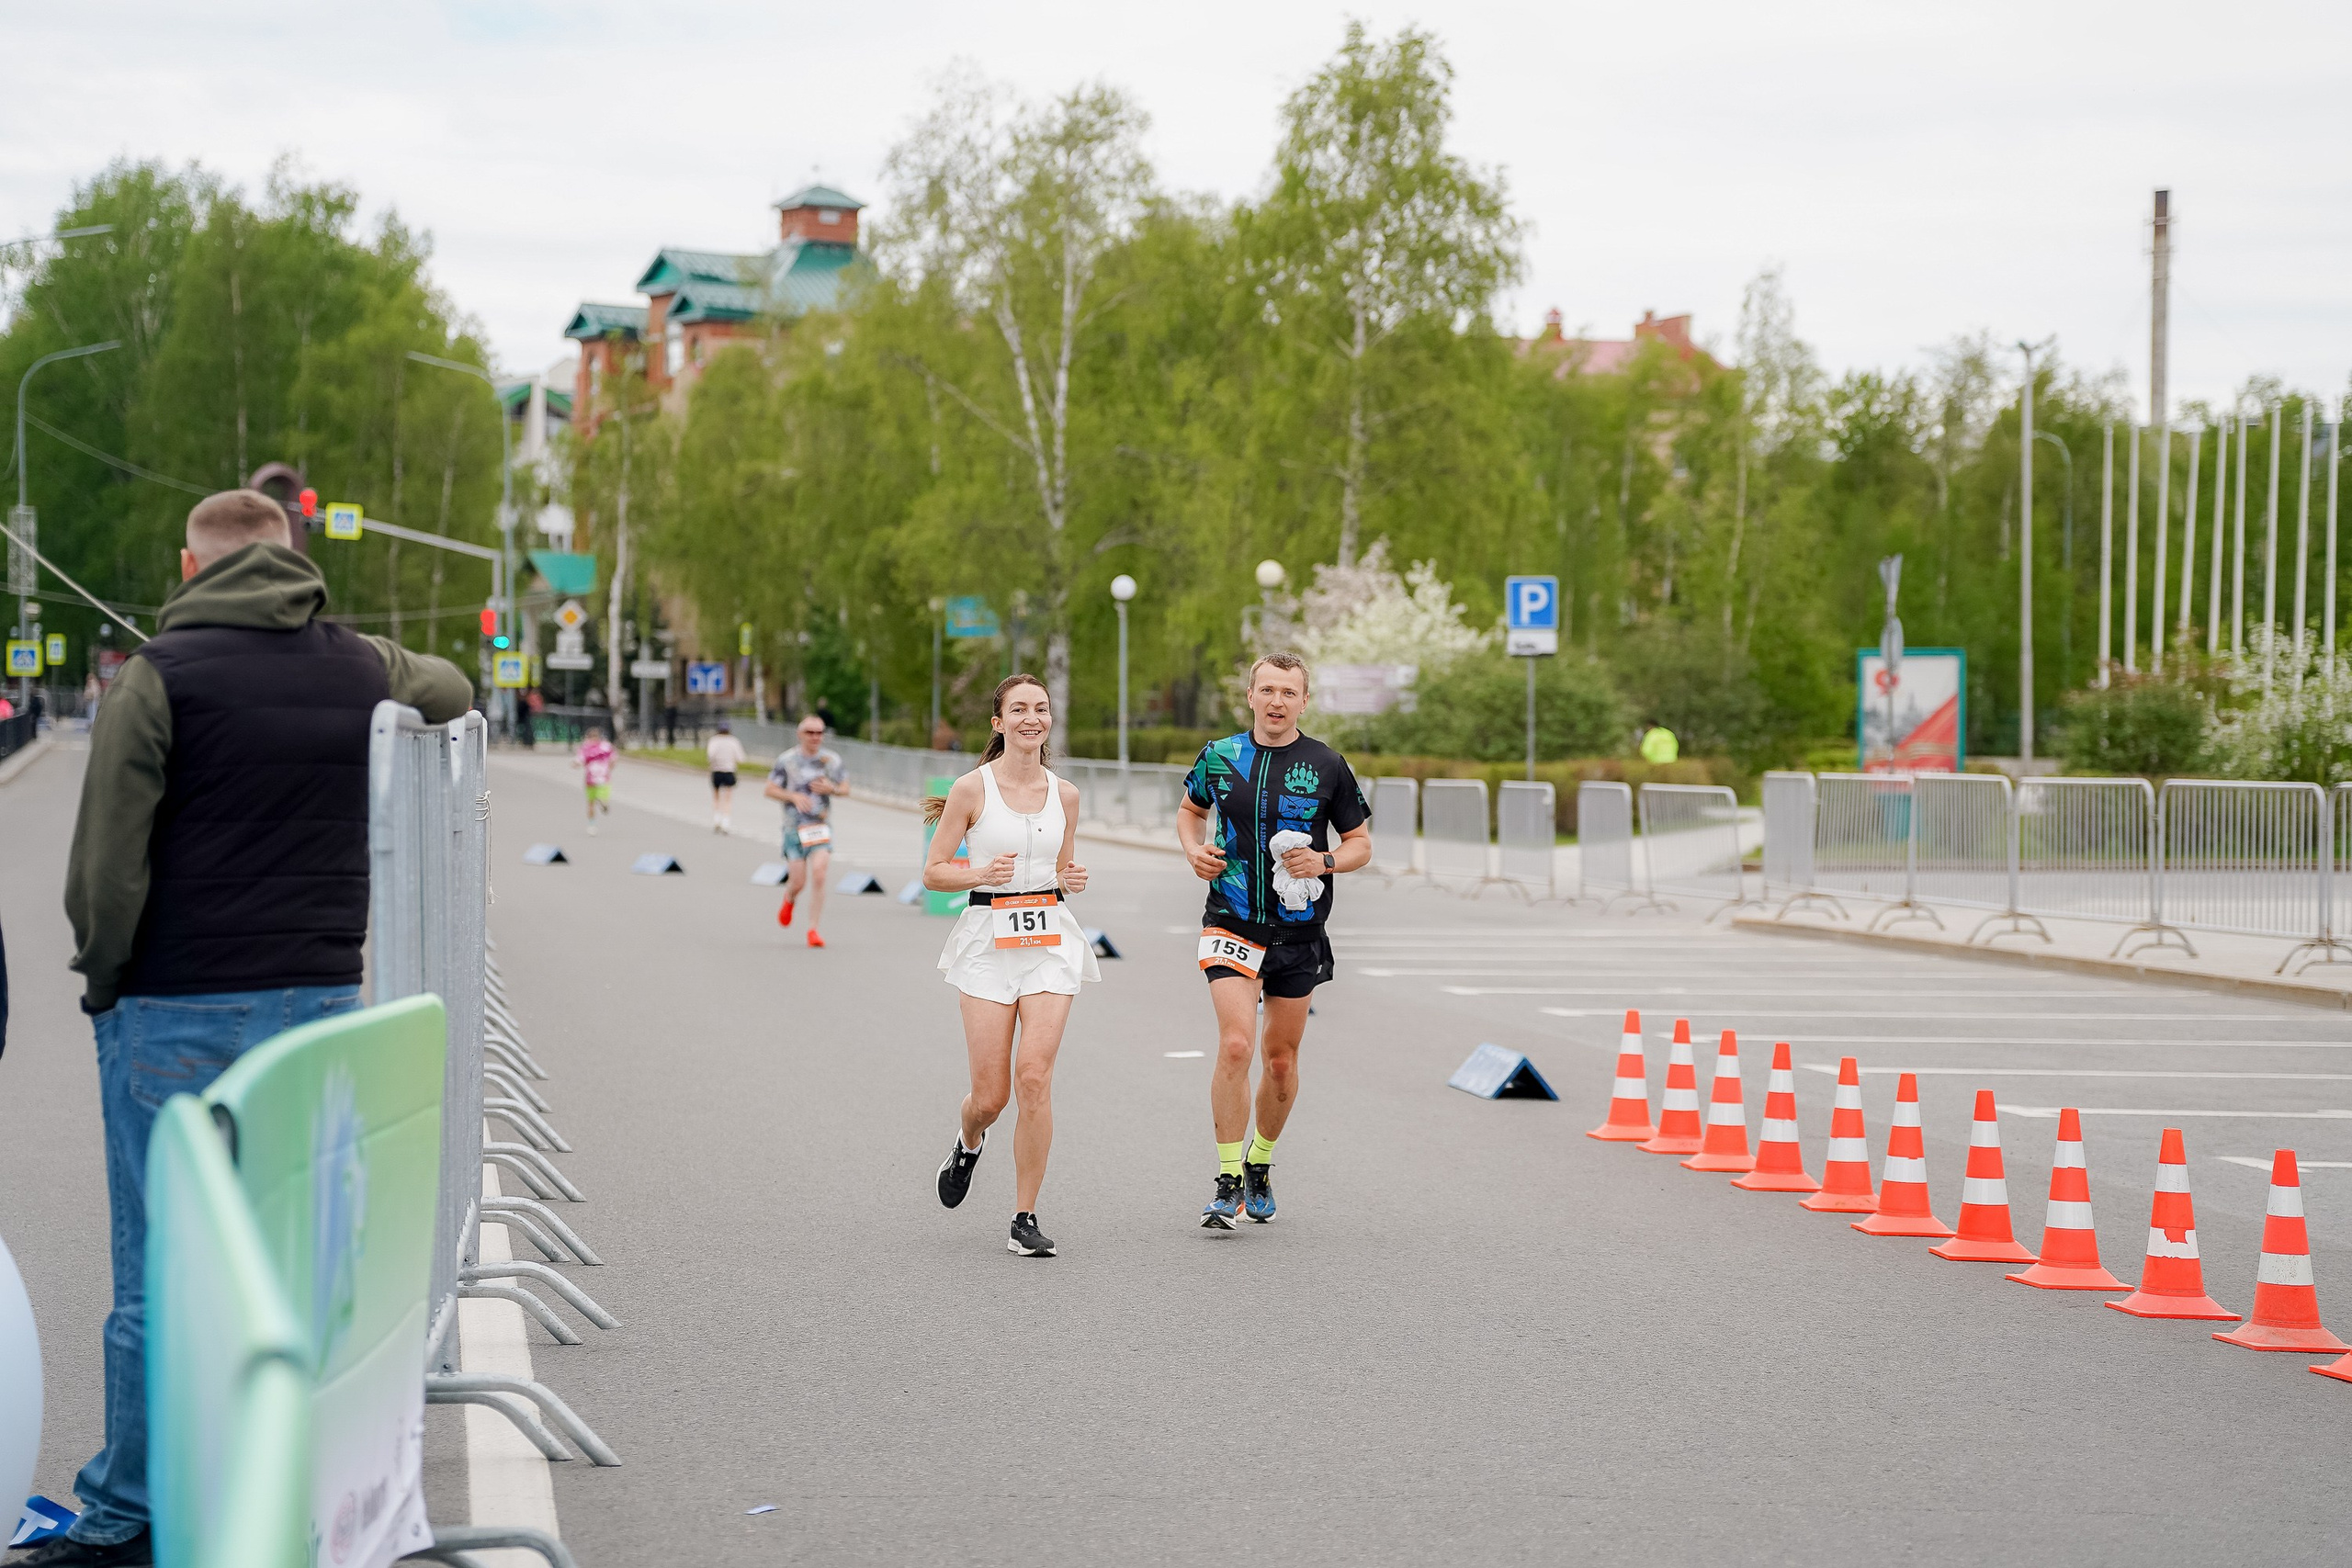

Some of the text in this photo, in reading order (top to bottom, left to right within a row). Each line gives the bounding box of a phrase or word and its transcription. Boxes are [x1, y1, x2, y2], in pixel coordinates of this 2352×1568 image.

[1520, 582, 1550, 625] P
[1009, 910, 1046, 931] 151
[1211, 939, 1250, 961] 155
